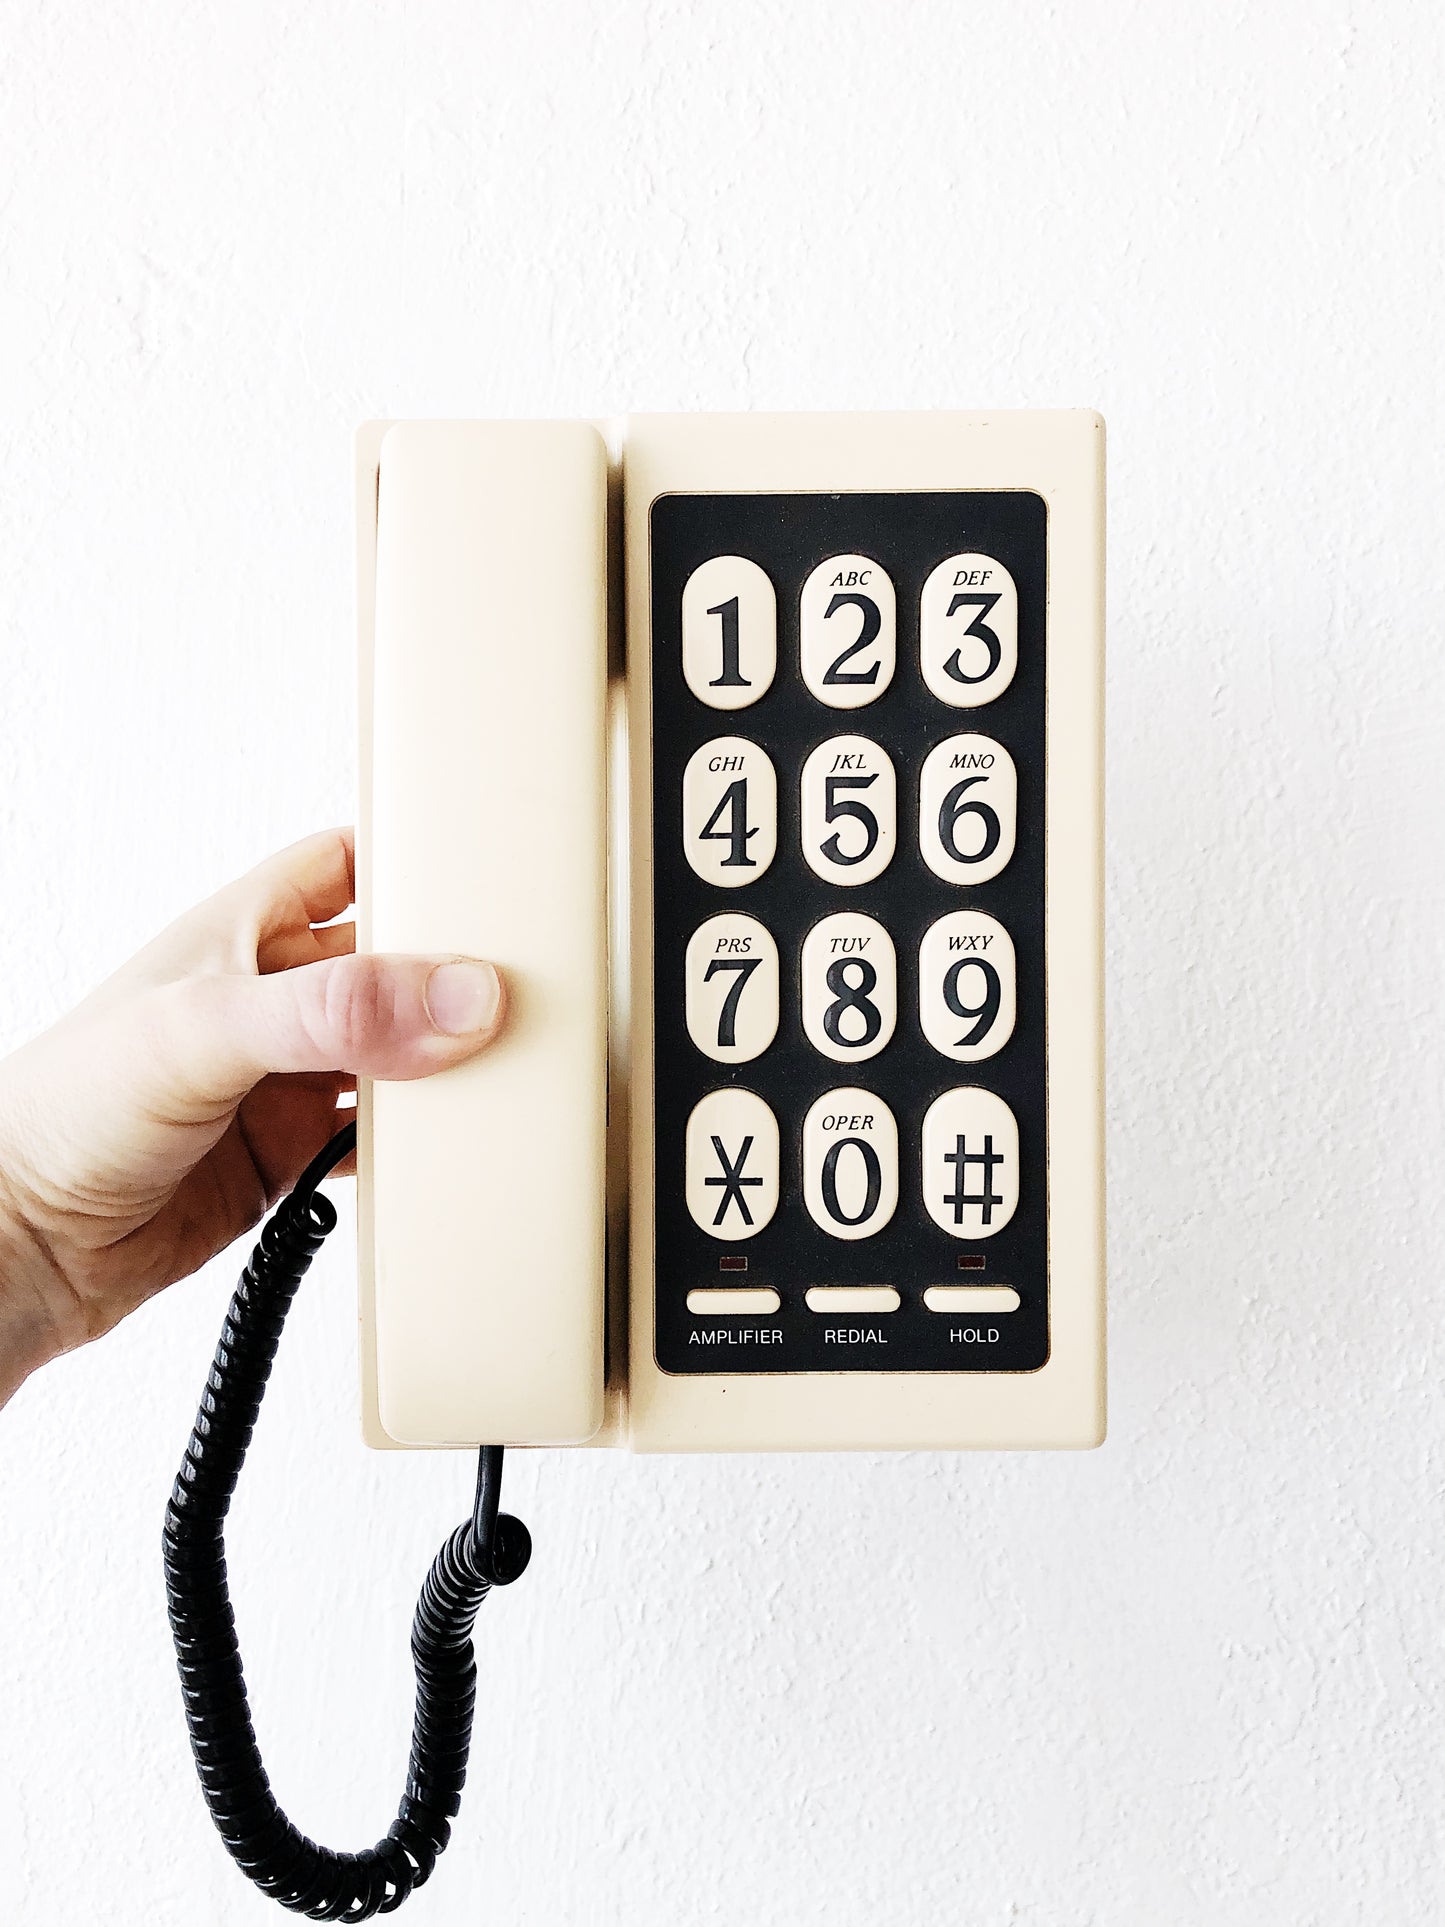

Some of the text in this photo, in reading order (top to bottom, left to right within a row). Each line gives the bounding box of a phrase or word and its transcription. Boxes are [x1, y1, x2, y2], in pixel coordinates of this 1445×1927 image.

[830, 571, 871, 586] ABC
[953, 571, 992, 585] DEF
[707, 596, 751, 686] 1
[823, 593, 881, 685] 2
[943, 593, 1002, 684] 3
[709, 757, 744, 771] GHI
[831, 755, 866, 772] JKL
[950, 754, 994, 769] MNO
[699, 778, 759, 866] 4
[820, 774, 879, 866] 5
[938, 777, 1000, 864] 6
[716, 938, 751, 952] PRS
[831, 938, 870, 952] TUV
[950, 936, 993, 950] WXY
[704, 959, 763, 1046] 7
[824, 957, 881, 1047] 8
[943, 957, 1001, 1046] 9
[823, 1116, 873, 1130] OPER
[821, 1138, 881, 1226] 0
[944, 1135, 1004, 1224] #
[689, 1330, 782, 1344] AMPLIFIER
[825, 1330, 887, 1343] REDIAL
[951, 1329, 999, 1342] HOLD
